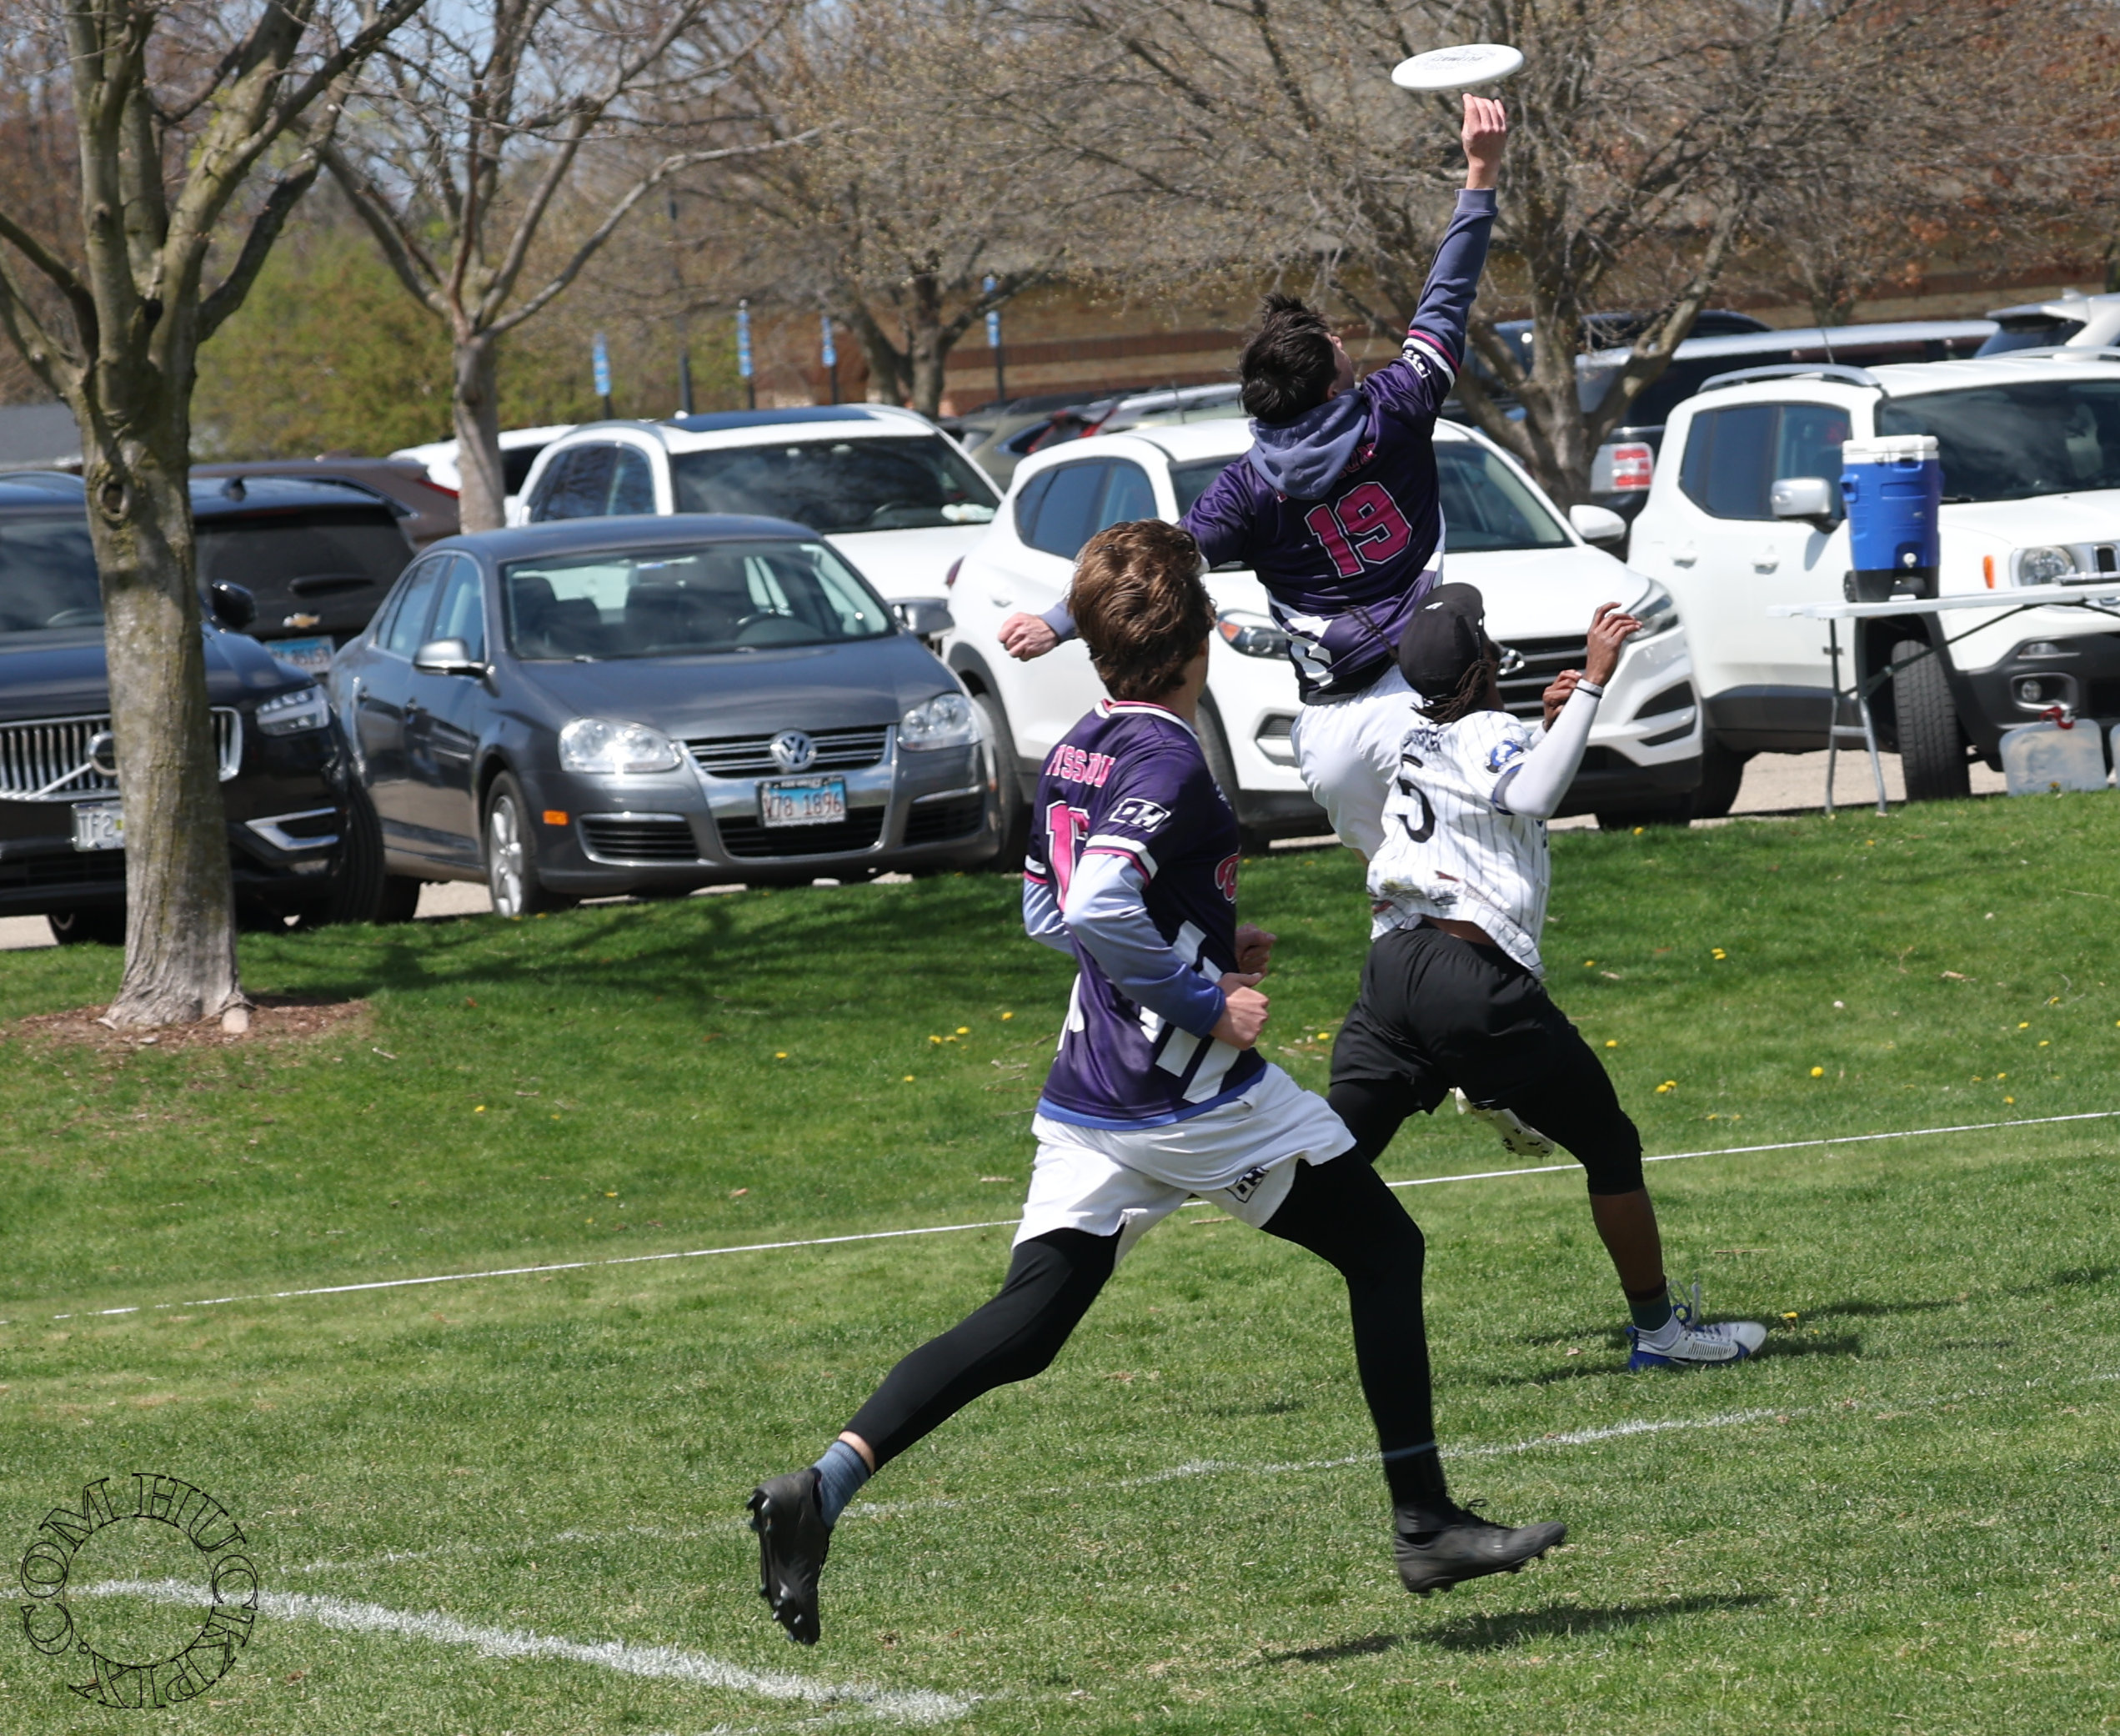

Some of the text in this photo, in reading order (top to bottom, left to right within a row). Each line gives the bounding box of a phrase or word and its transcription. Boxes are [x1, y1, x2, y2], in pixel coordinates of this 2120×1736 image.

[1305, 481, 1412, 578] 19
[804, 791, 842, 816] 1896
[77, 812, 114, 839] TF2
